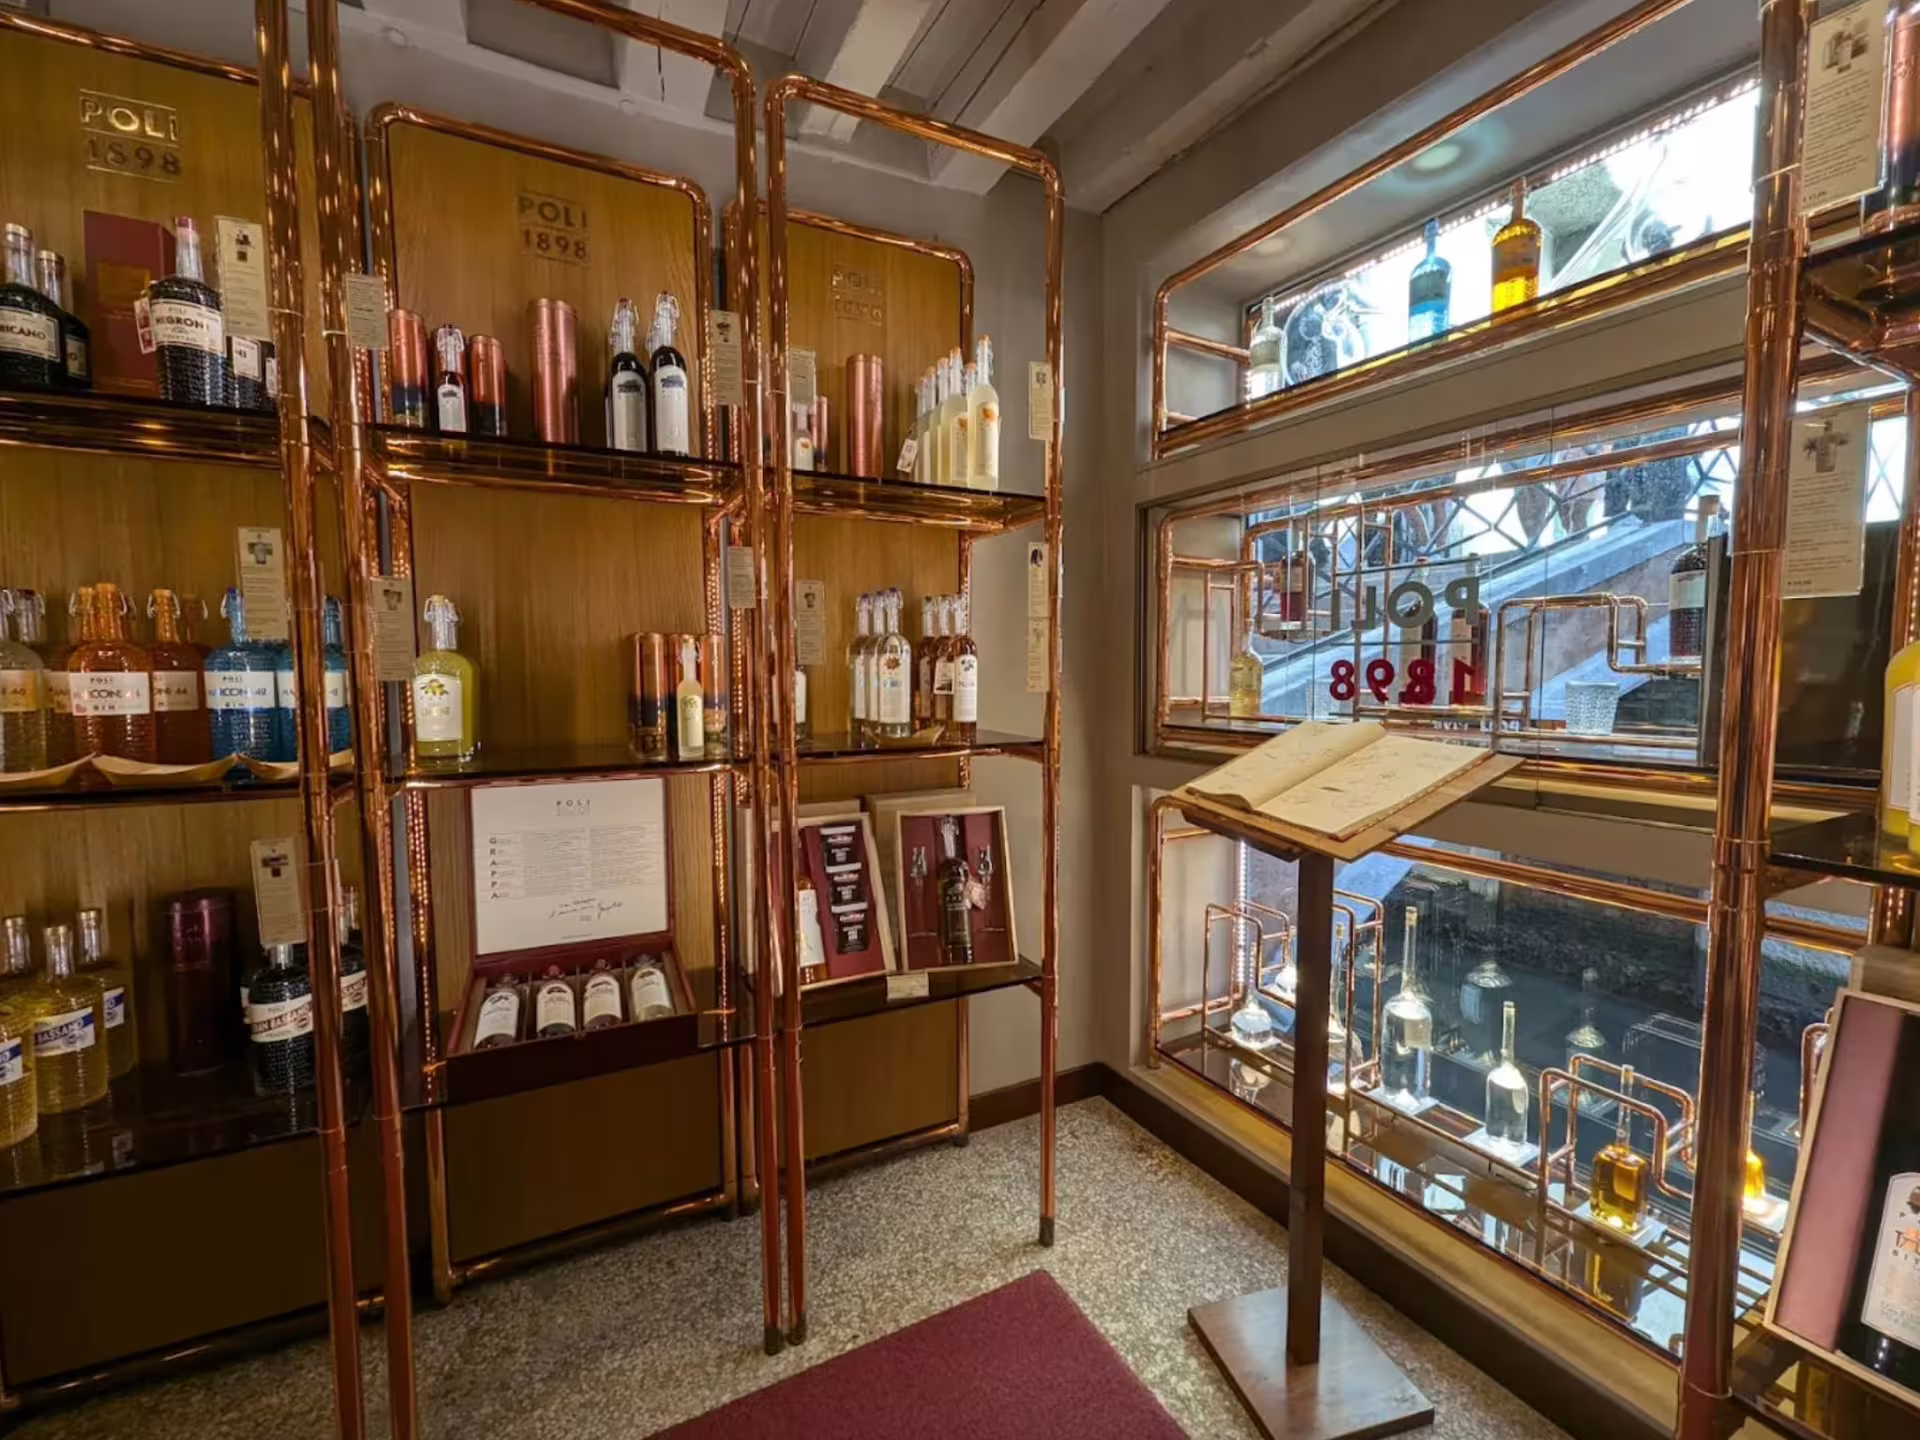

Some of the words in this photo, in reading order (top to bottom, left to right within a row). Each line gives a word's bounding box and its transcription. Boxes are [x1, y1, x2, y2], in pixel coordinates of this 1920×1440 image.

[80, 97, 178, 141] POLI
[89, 138, 181, 174] 1898
[519, 195, 587, 229] POLI
[524, 229, 587, 259] 1898
